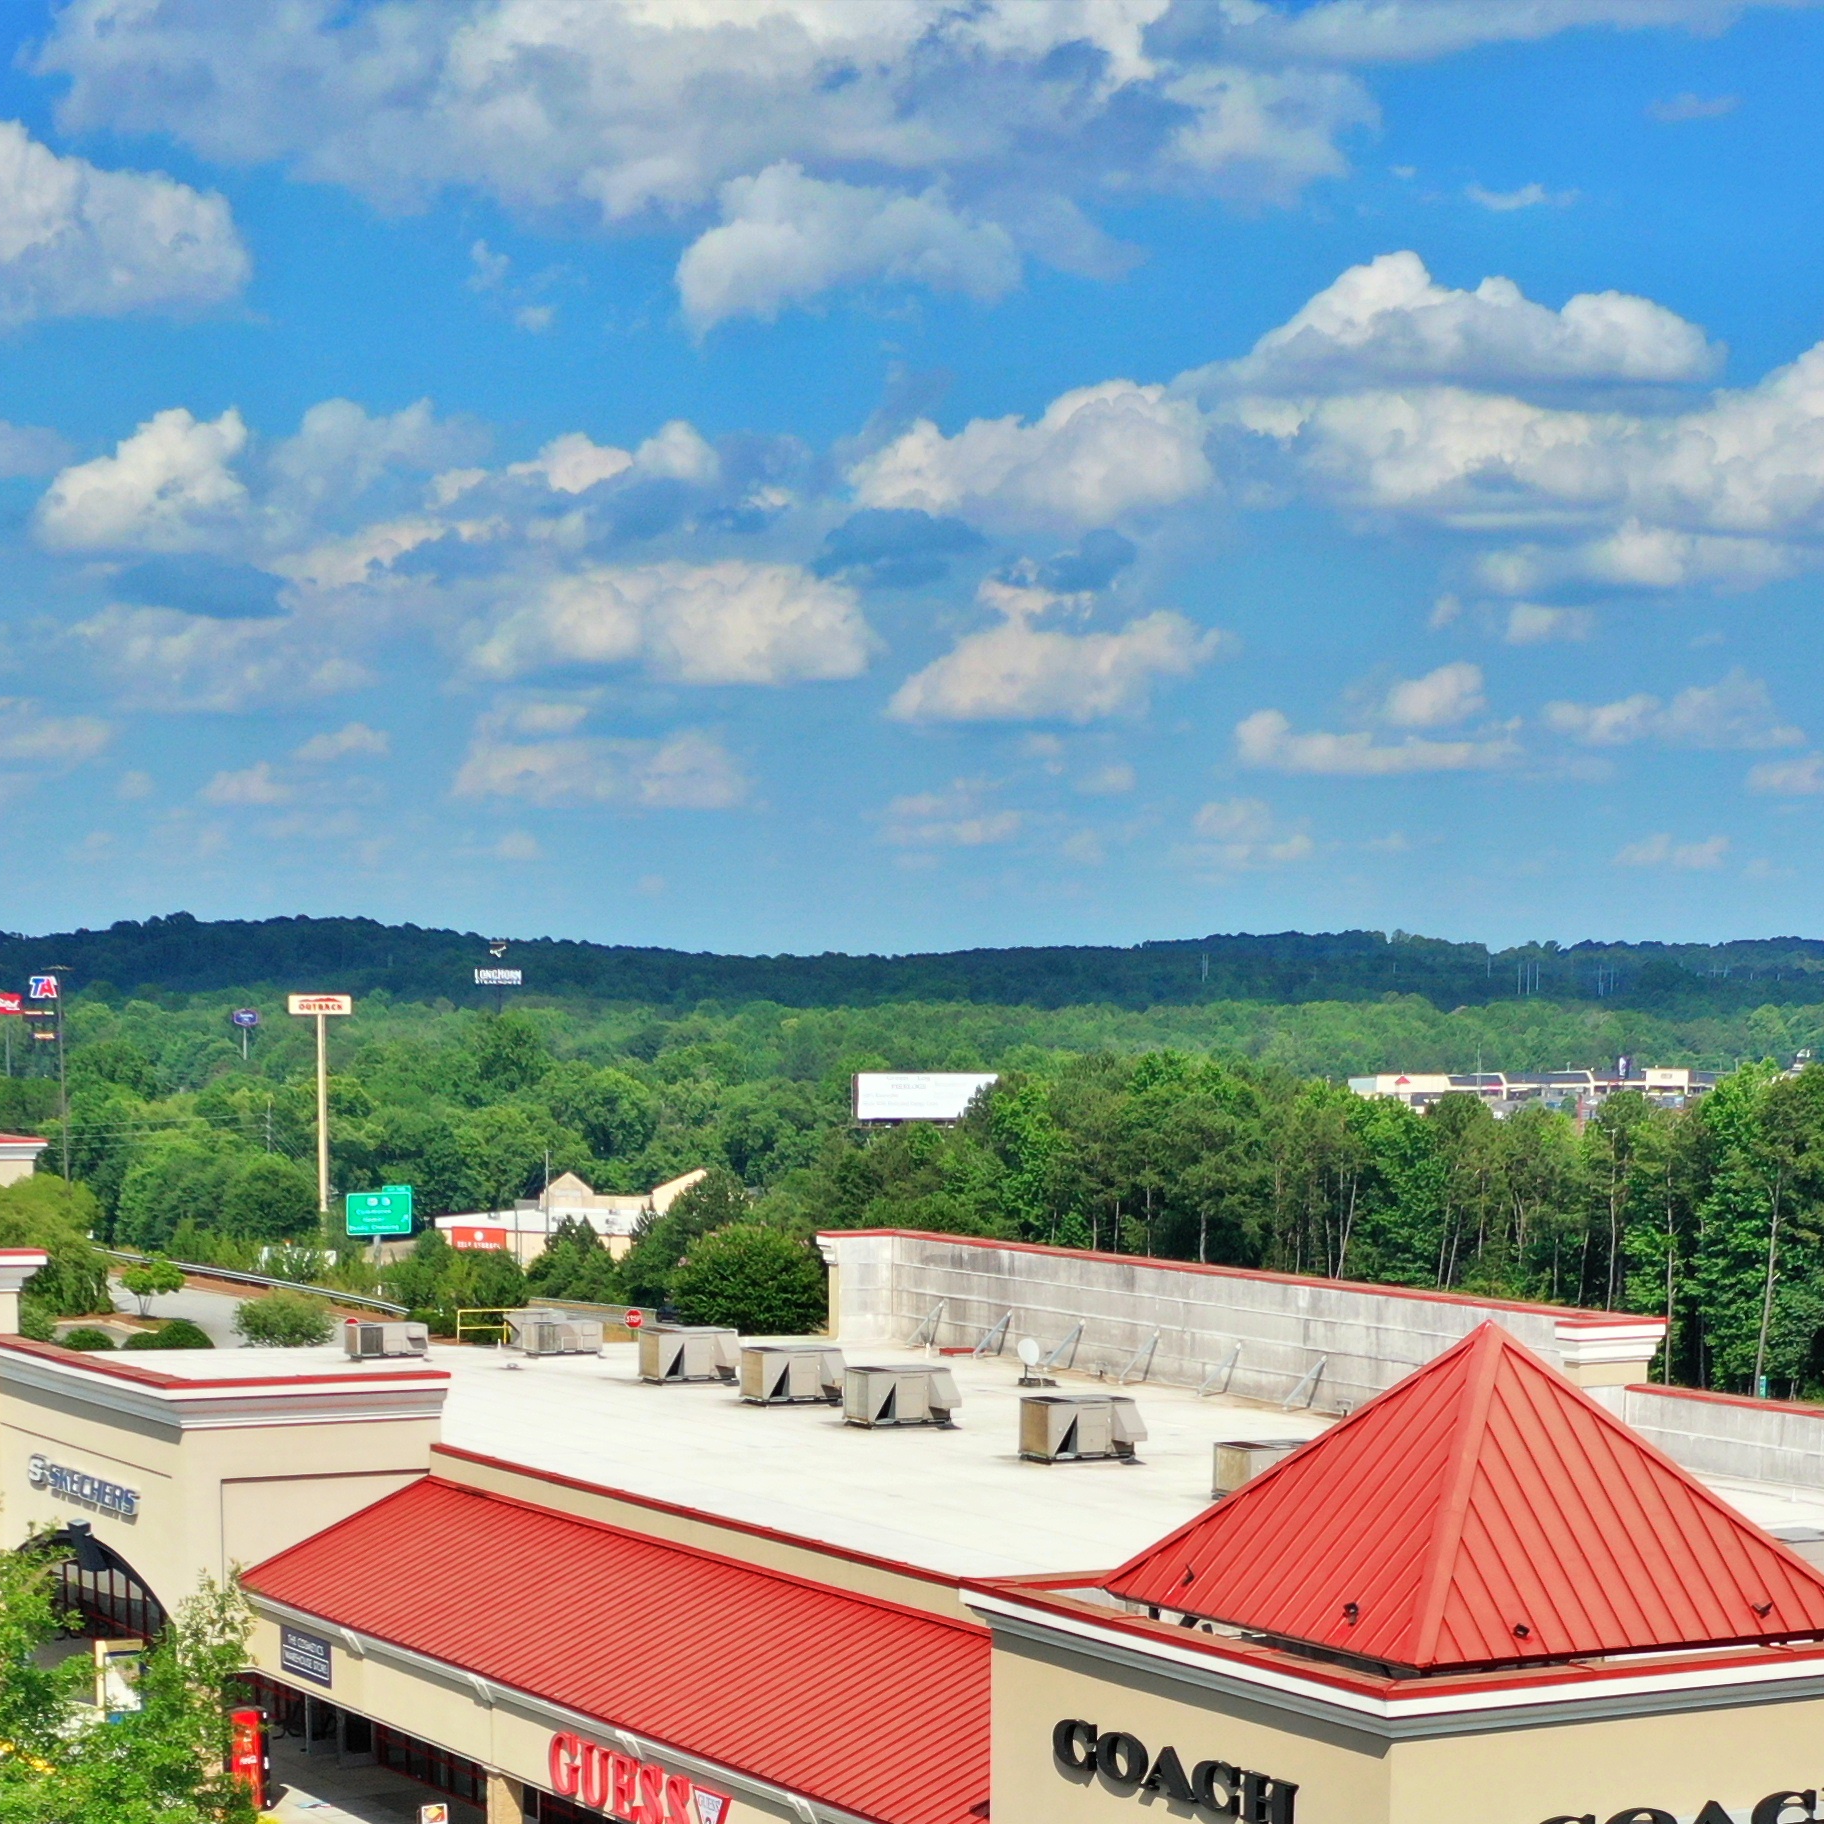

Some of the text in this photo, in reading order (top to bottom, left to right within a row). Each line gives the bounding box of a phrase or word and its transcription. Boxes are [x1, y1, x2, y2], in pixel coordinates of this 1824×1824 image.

[29, 975, 58, 998] TA
[298, 1003, 343, 1011] OUTBACK
[49, 1463, 140, 1516] SKECHERS
